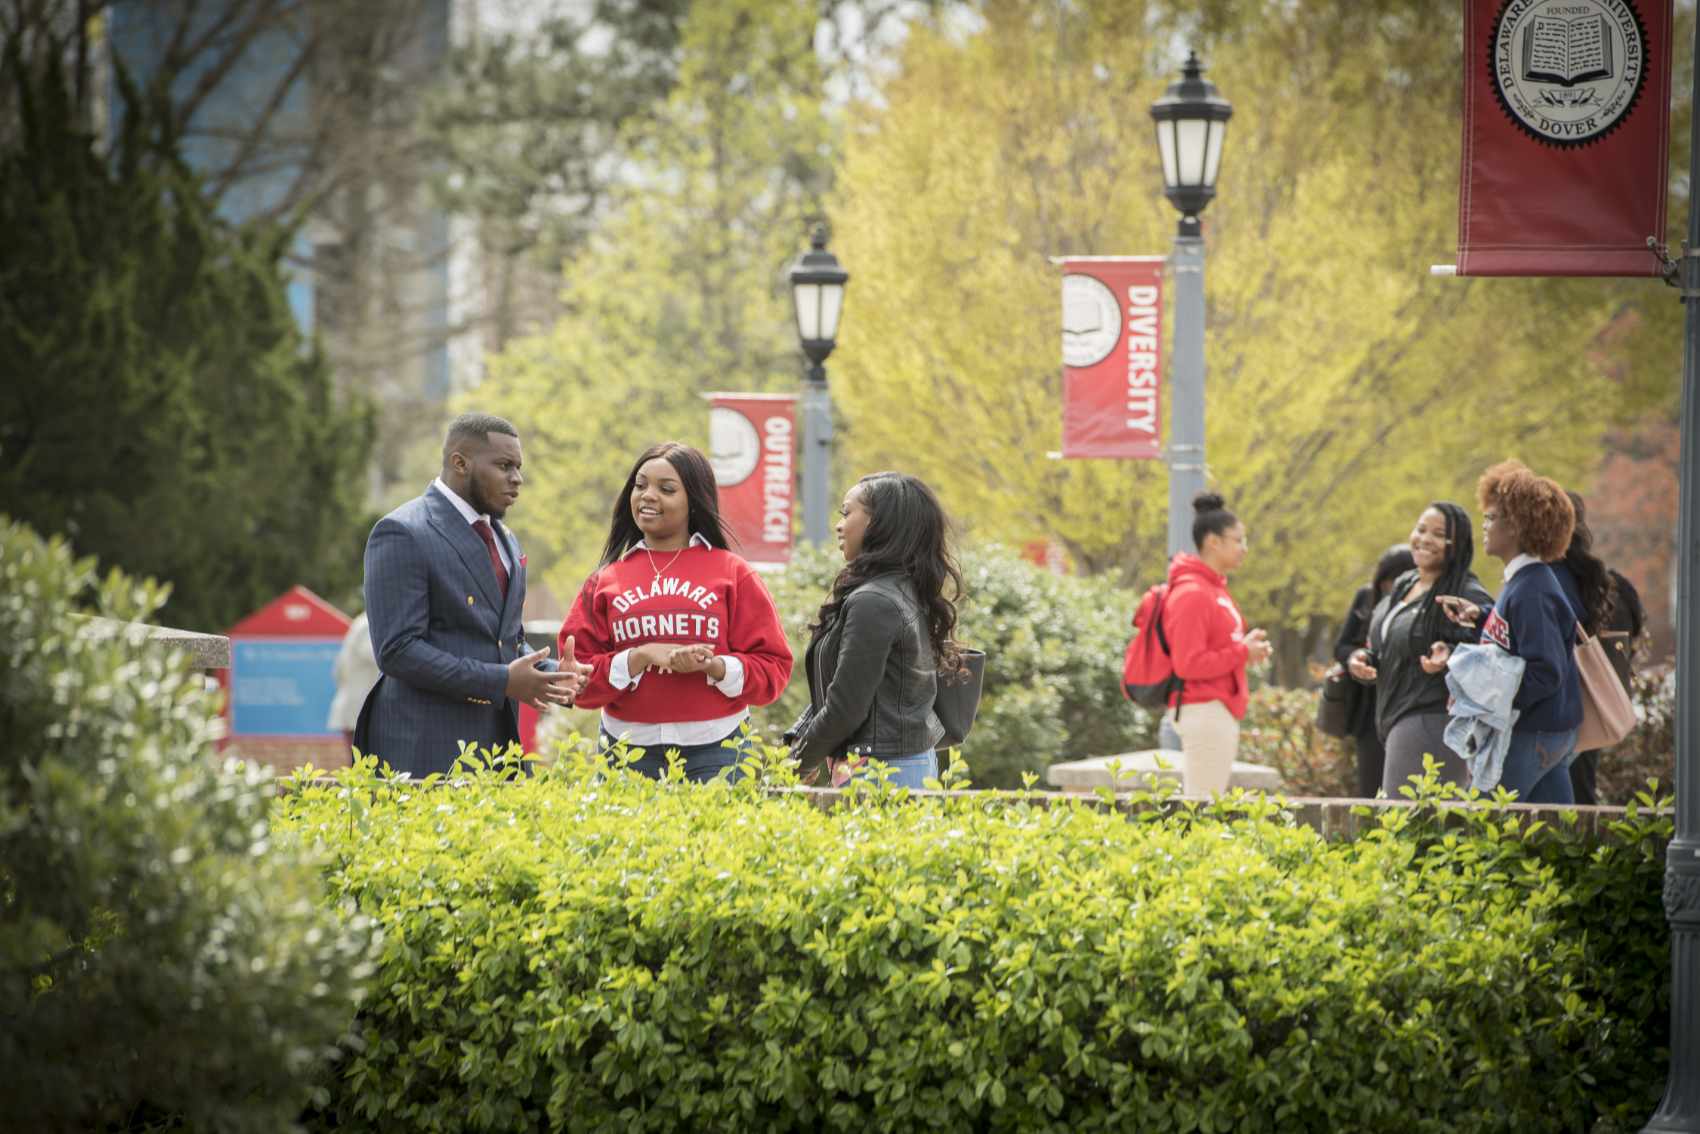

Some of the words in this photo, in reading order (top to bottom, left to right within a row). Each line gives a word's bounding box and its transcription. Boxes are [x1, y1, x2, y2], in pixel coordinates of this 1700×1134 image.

[1547, 6, 1590, 15] FOUNDED
[1606, 0, 1639, 87] NIVERSITY
[1538, 118, 1598, 136] DOVER
[1126, 285, 1158, 433] DIVERSITY
[763, 416, 792, 542] OUTREACH
[611, 577, 718, 614] DELAWARE
[612, 613, 720, 643] HORNETS
